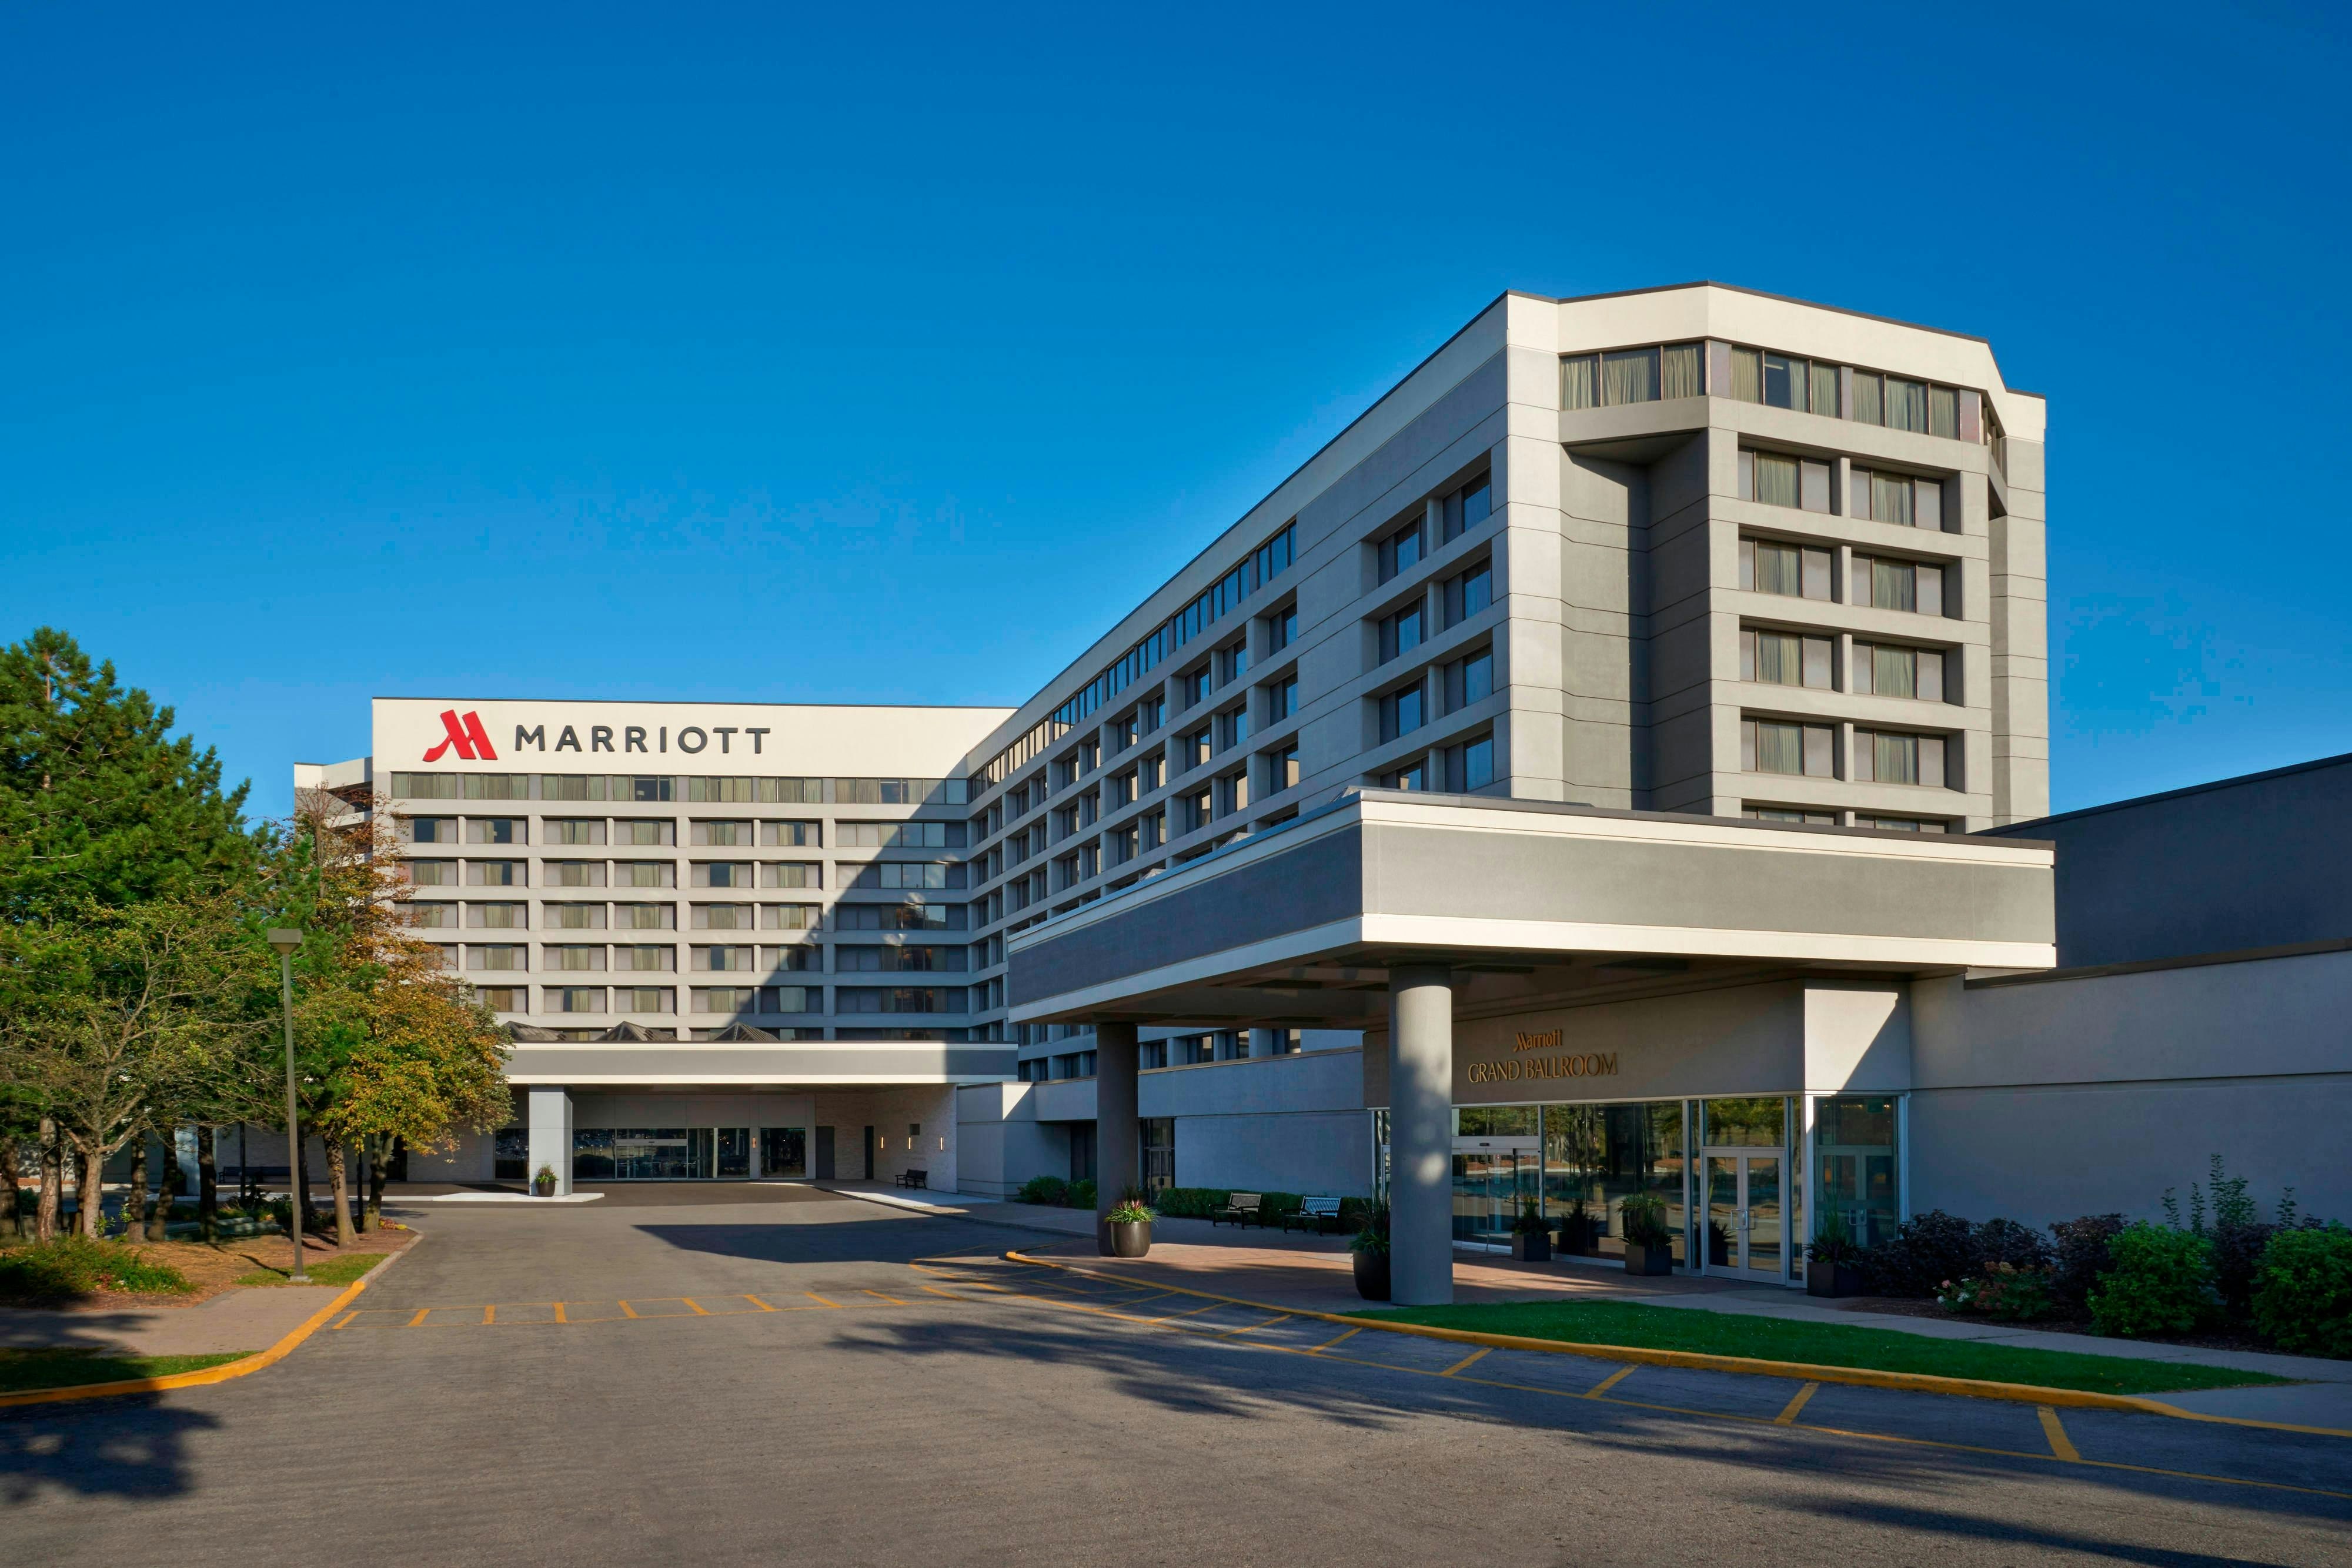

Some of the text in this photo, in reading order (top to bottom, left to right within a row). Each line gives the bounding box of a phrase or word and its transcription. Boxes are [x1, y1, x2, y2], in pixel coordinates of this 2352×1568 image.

[515, 724, 770, 754] MARRIOTT
[1514, 1029, 1562, 1052] Marriott
[1468, 1052, 1618, 1083] GRAND BALLROOM
